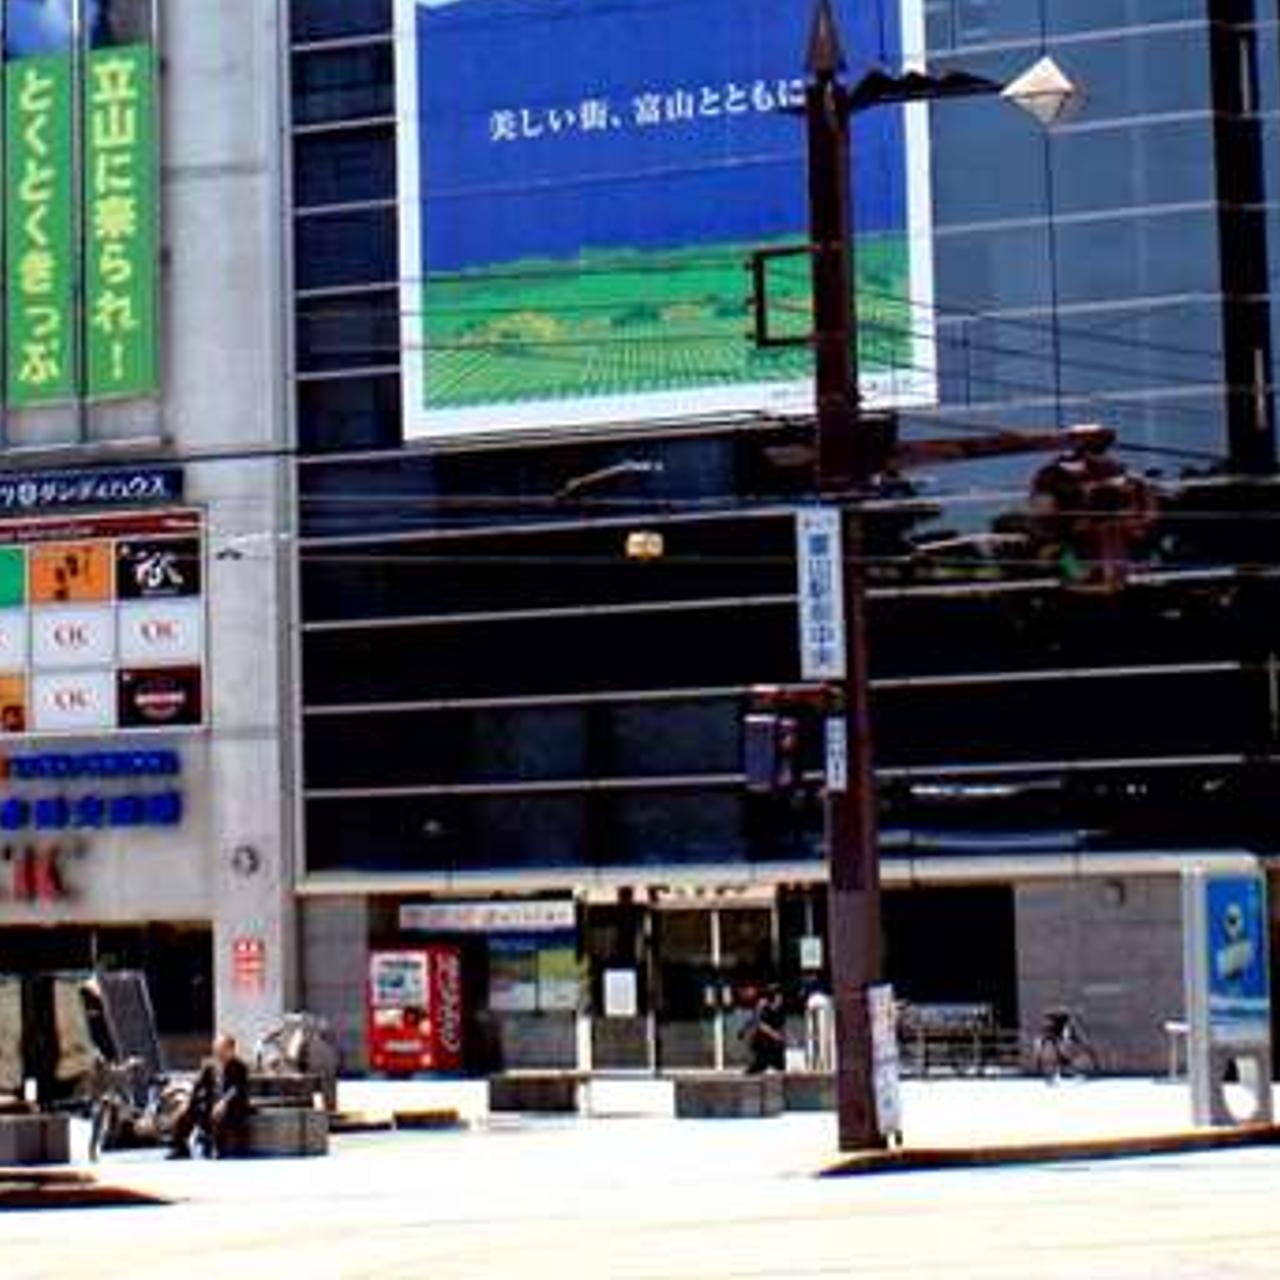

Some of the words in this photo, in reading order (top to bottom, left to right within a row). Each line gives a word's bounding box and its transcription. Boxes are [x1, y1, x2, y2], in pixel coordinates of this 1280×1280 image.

[489, 79, 806, 141] 美しい街、富山とともに
[19, 67, 61, 384] とくとくきっぷ
